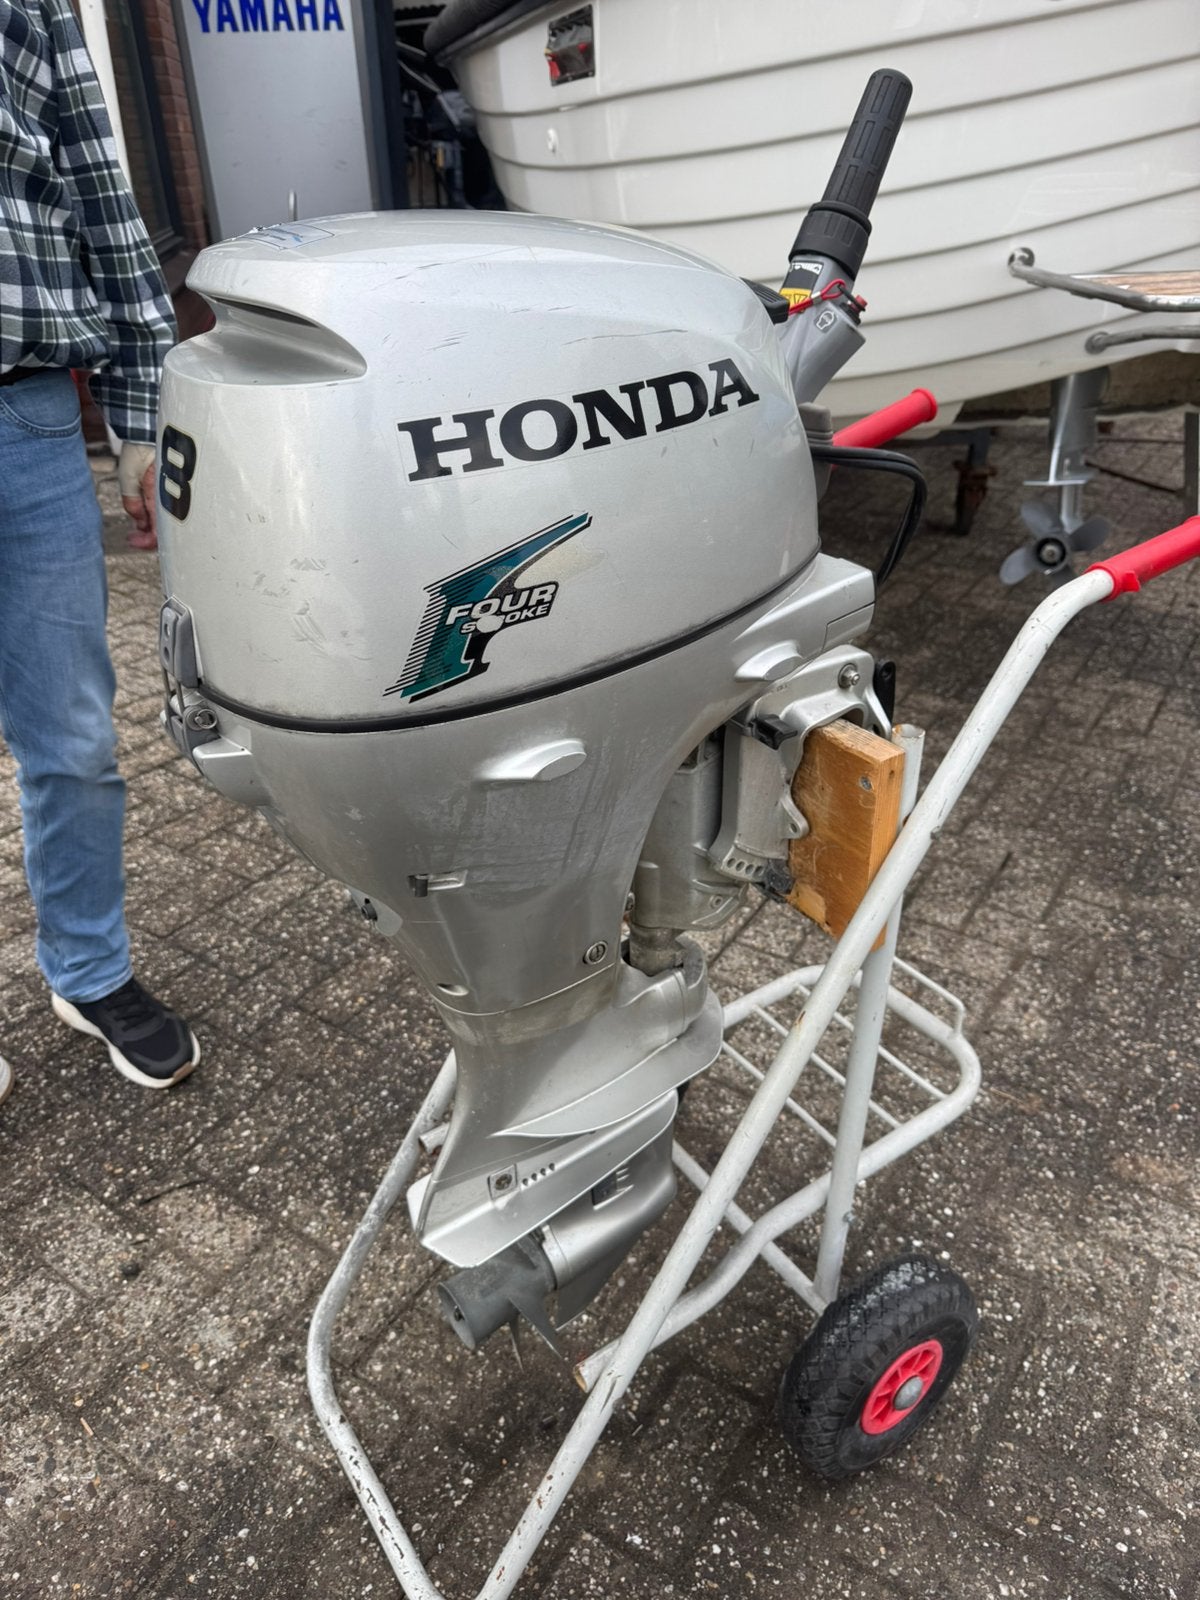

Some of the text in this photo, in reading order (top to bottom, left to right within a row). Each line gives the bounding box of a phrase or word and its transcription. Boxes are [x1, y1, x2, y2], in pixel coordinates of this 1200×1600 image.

[191, 0, 345, 33] YAMAHA
[397, 358, 760, 482] HONDA
[159, 424, 197, 521] 8
[445, 584, 557, 625] FOUR
[461, 603, 550, 634] SOKE
